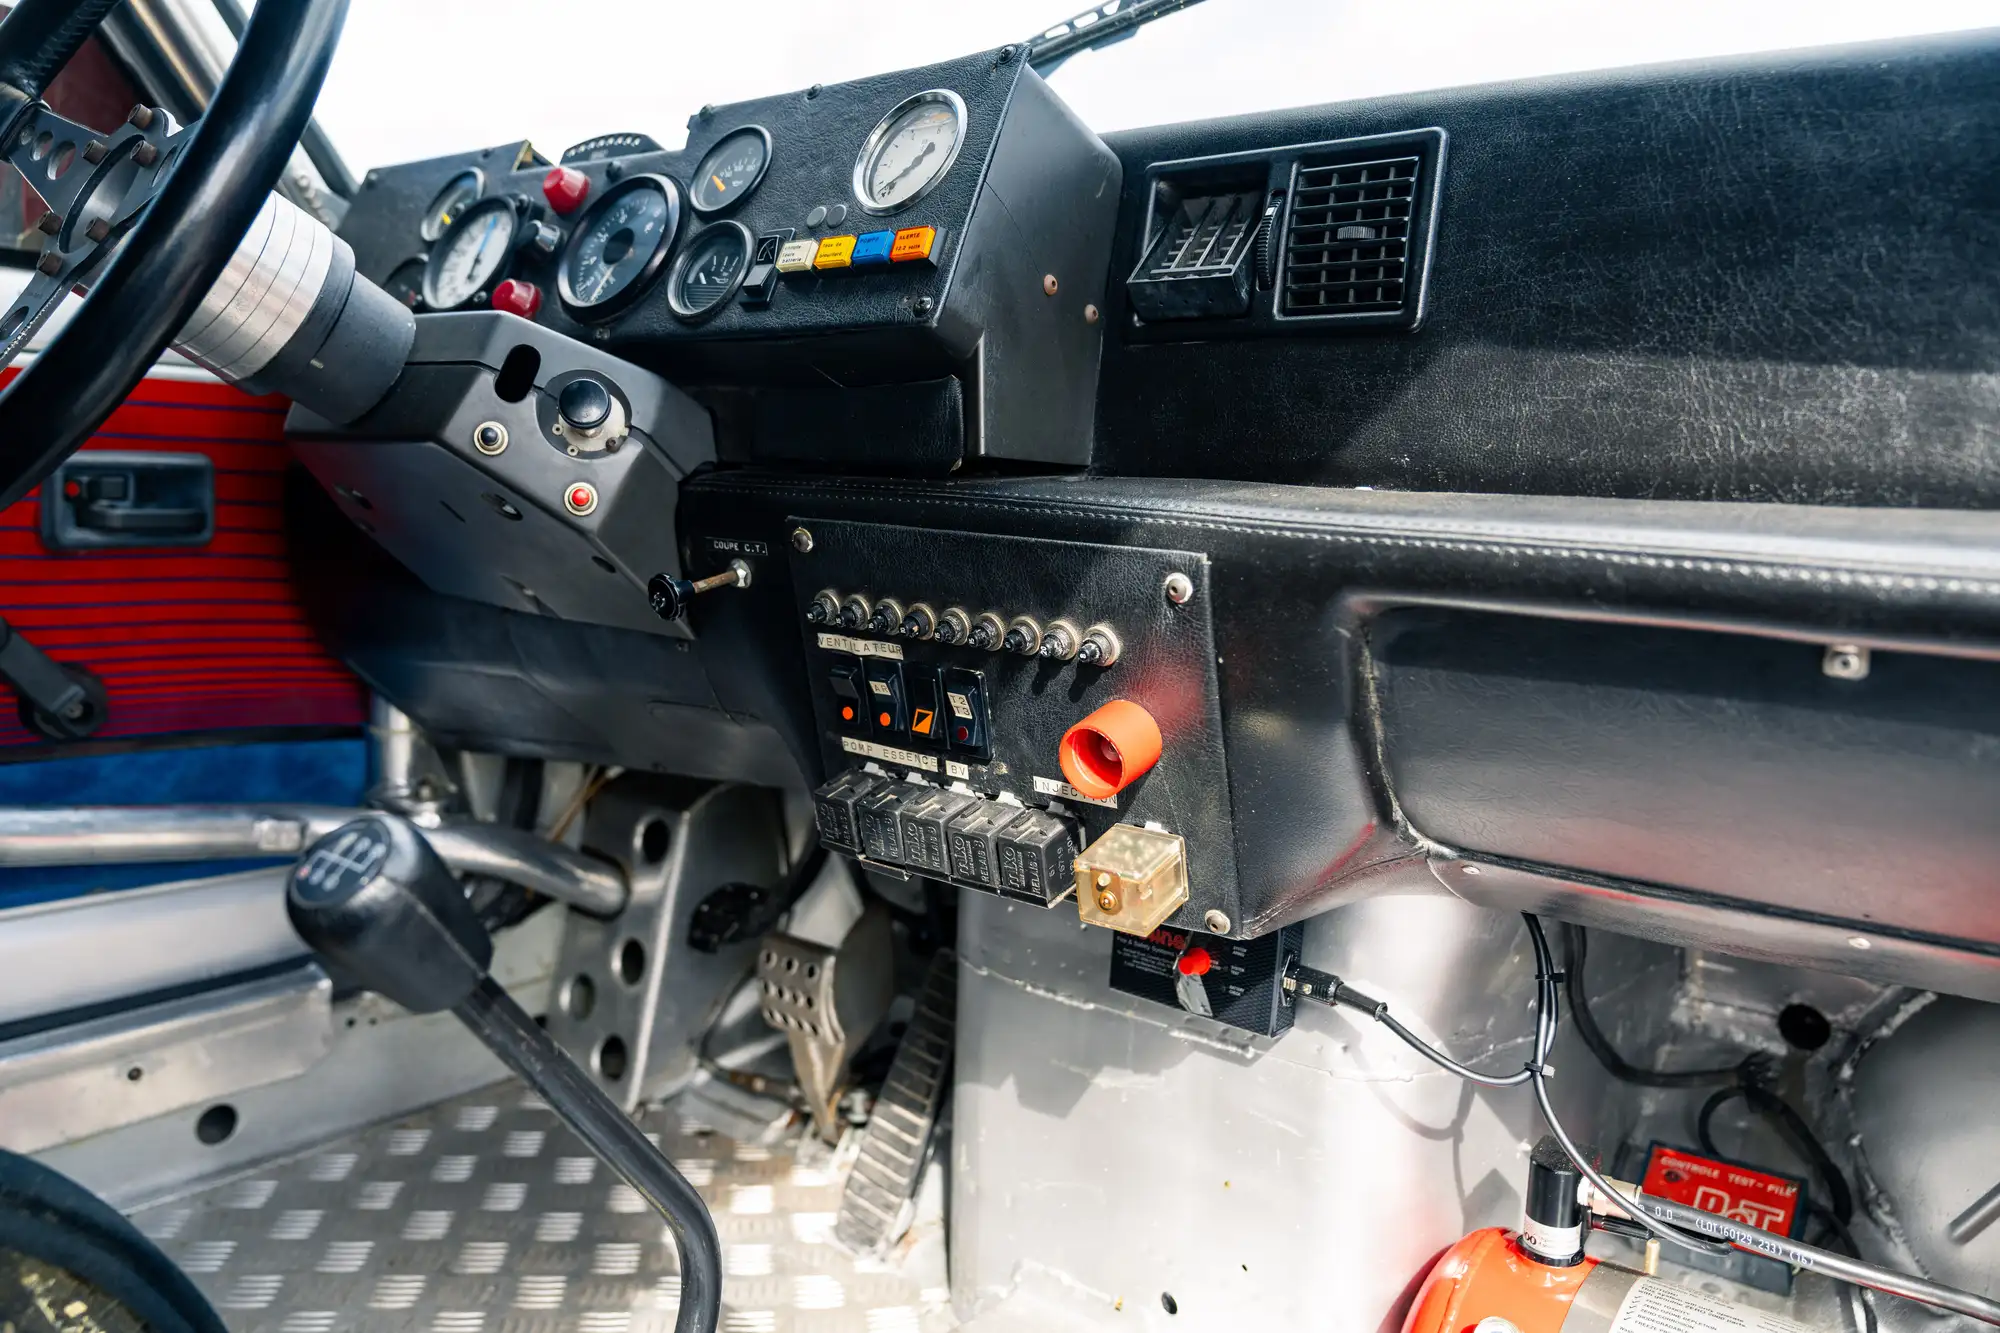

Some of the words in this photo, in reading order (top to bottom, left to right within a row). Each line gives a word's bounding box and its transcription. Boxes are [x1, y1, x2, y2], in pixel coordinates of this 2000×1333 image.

[899, 232, 921, 241] ALERTE
[713, 540, 739, 551] COUPE
[744, 543, 766, 554] C.T.
[818, 636, 902, 655] VENTILATEUR
[1040, 645, 1048, 656] 20
[874, 684, 889, 693] AR
[949, 694, 966, 706] T2
[953, 706, 971, 716] T3
[843, 741, 873, 754] POMP
[883, 748, 937, 768] ESSENCE
[950, 763, 966, 775] BV
[1034, 780, 1117, 804] INJECN
[886, 828, 899, 858] RELAIS
[929, 837, 942, 868] RELAIS
[976, 849, 990, 883] RELAIS
[1029, 860, 1044, 895] RELAIS
[1661, 1156, 1721, 1180] CONTROLE
[1645, 1298, 1662, 1306] ZERO
[1684, 1304, 1706, 1314] ZERO
[1640, 1308, 1657, 1317] ZERO
[1643, 1303, 1660, 1312] ZERO
[1660, 1309, 1682, 1319] OZONE
[1682, 1316, 1718, 1331] DEPLETION
